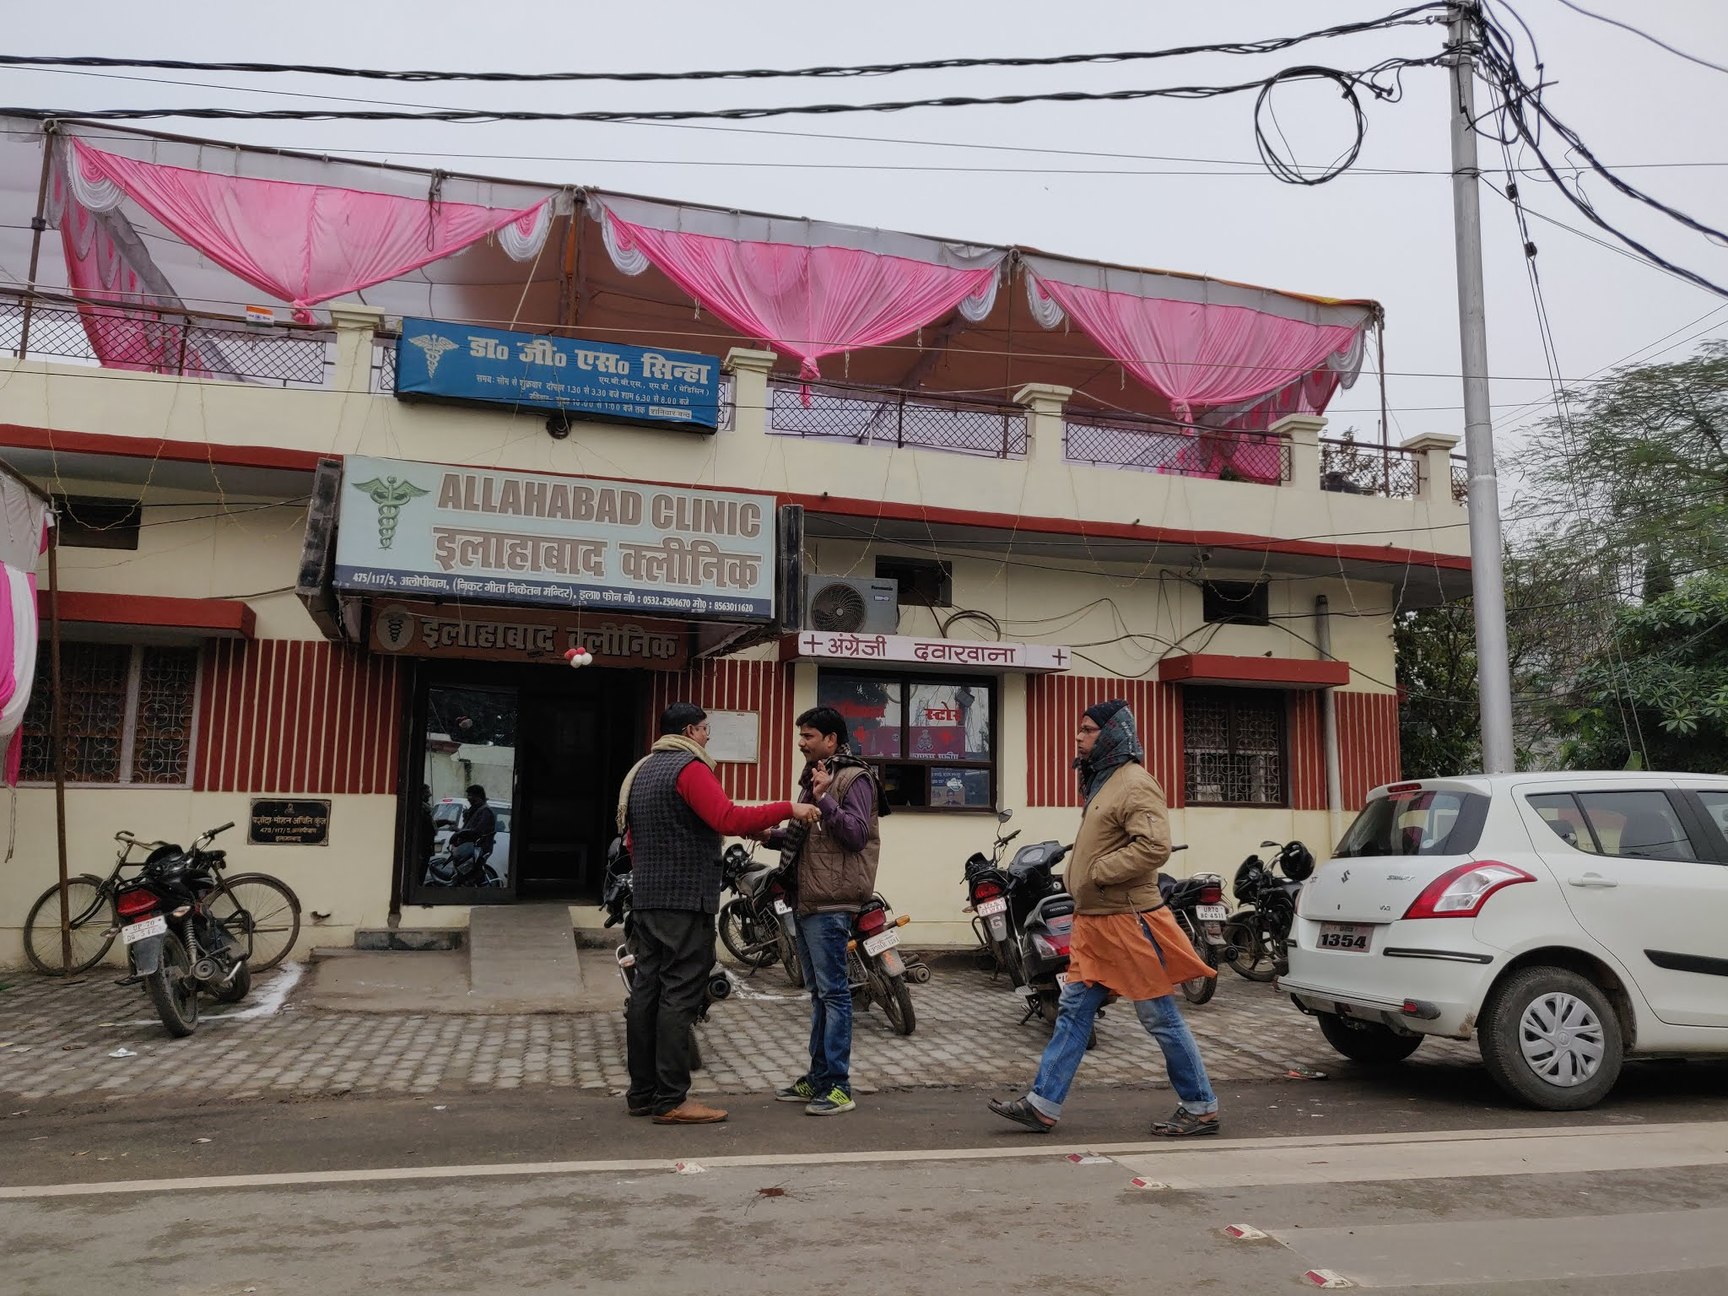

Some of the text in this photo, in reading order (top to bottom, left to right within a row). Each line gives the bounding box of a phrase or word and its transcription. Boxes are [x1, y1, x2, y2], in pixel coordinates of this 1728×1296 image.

[640, 352, 711, 385] सिन्हा
[436, 472, 762, 539] ALLAHABAD CLINIC
[432, 525, 762, 591] इलाहाबाद क्लीनिक
[507, 582, 542, 596] निकेतन
[602, 590, 622, 601] फोन
[420, 617, 680, 660] इलाहाबाद क्लीनिक
[827, 632, 887, 657] अंग्रेजी
[1321, 933, 1367, 949] 1354
